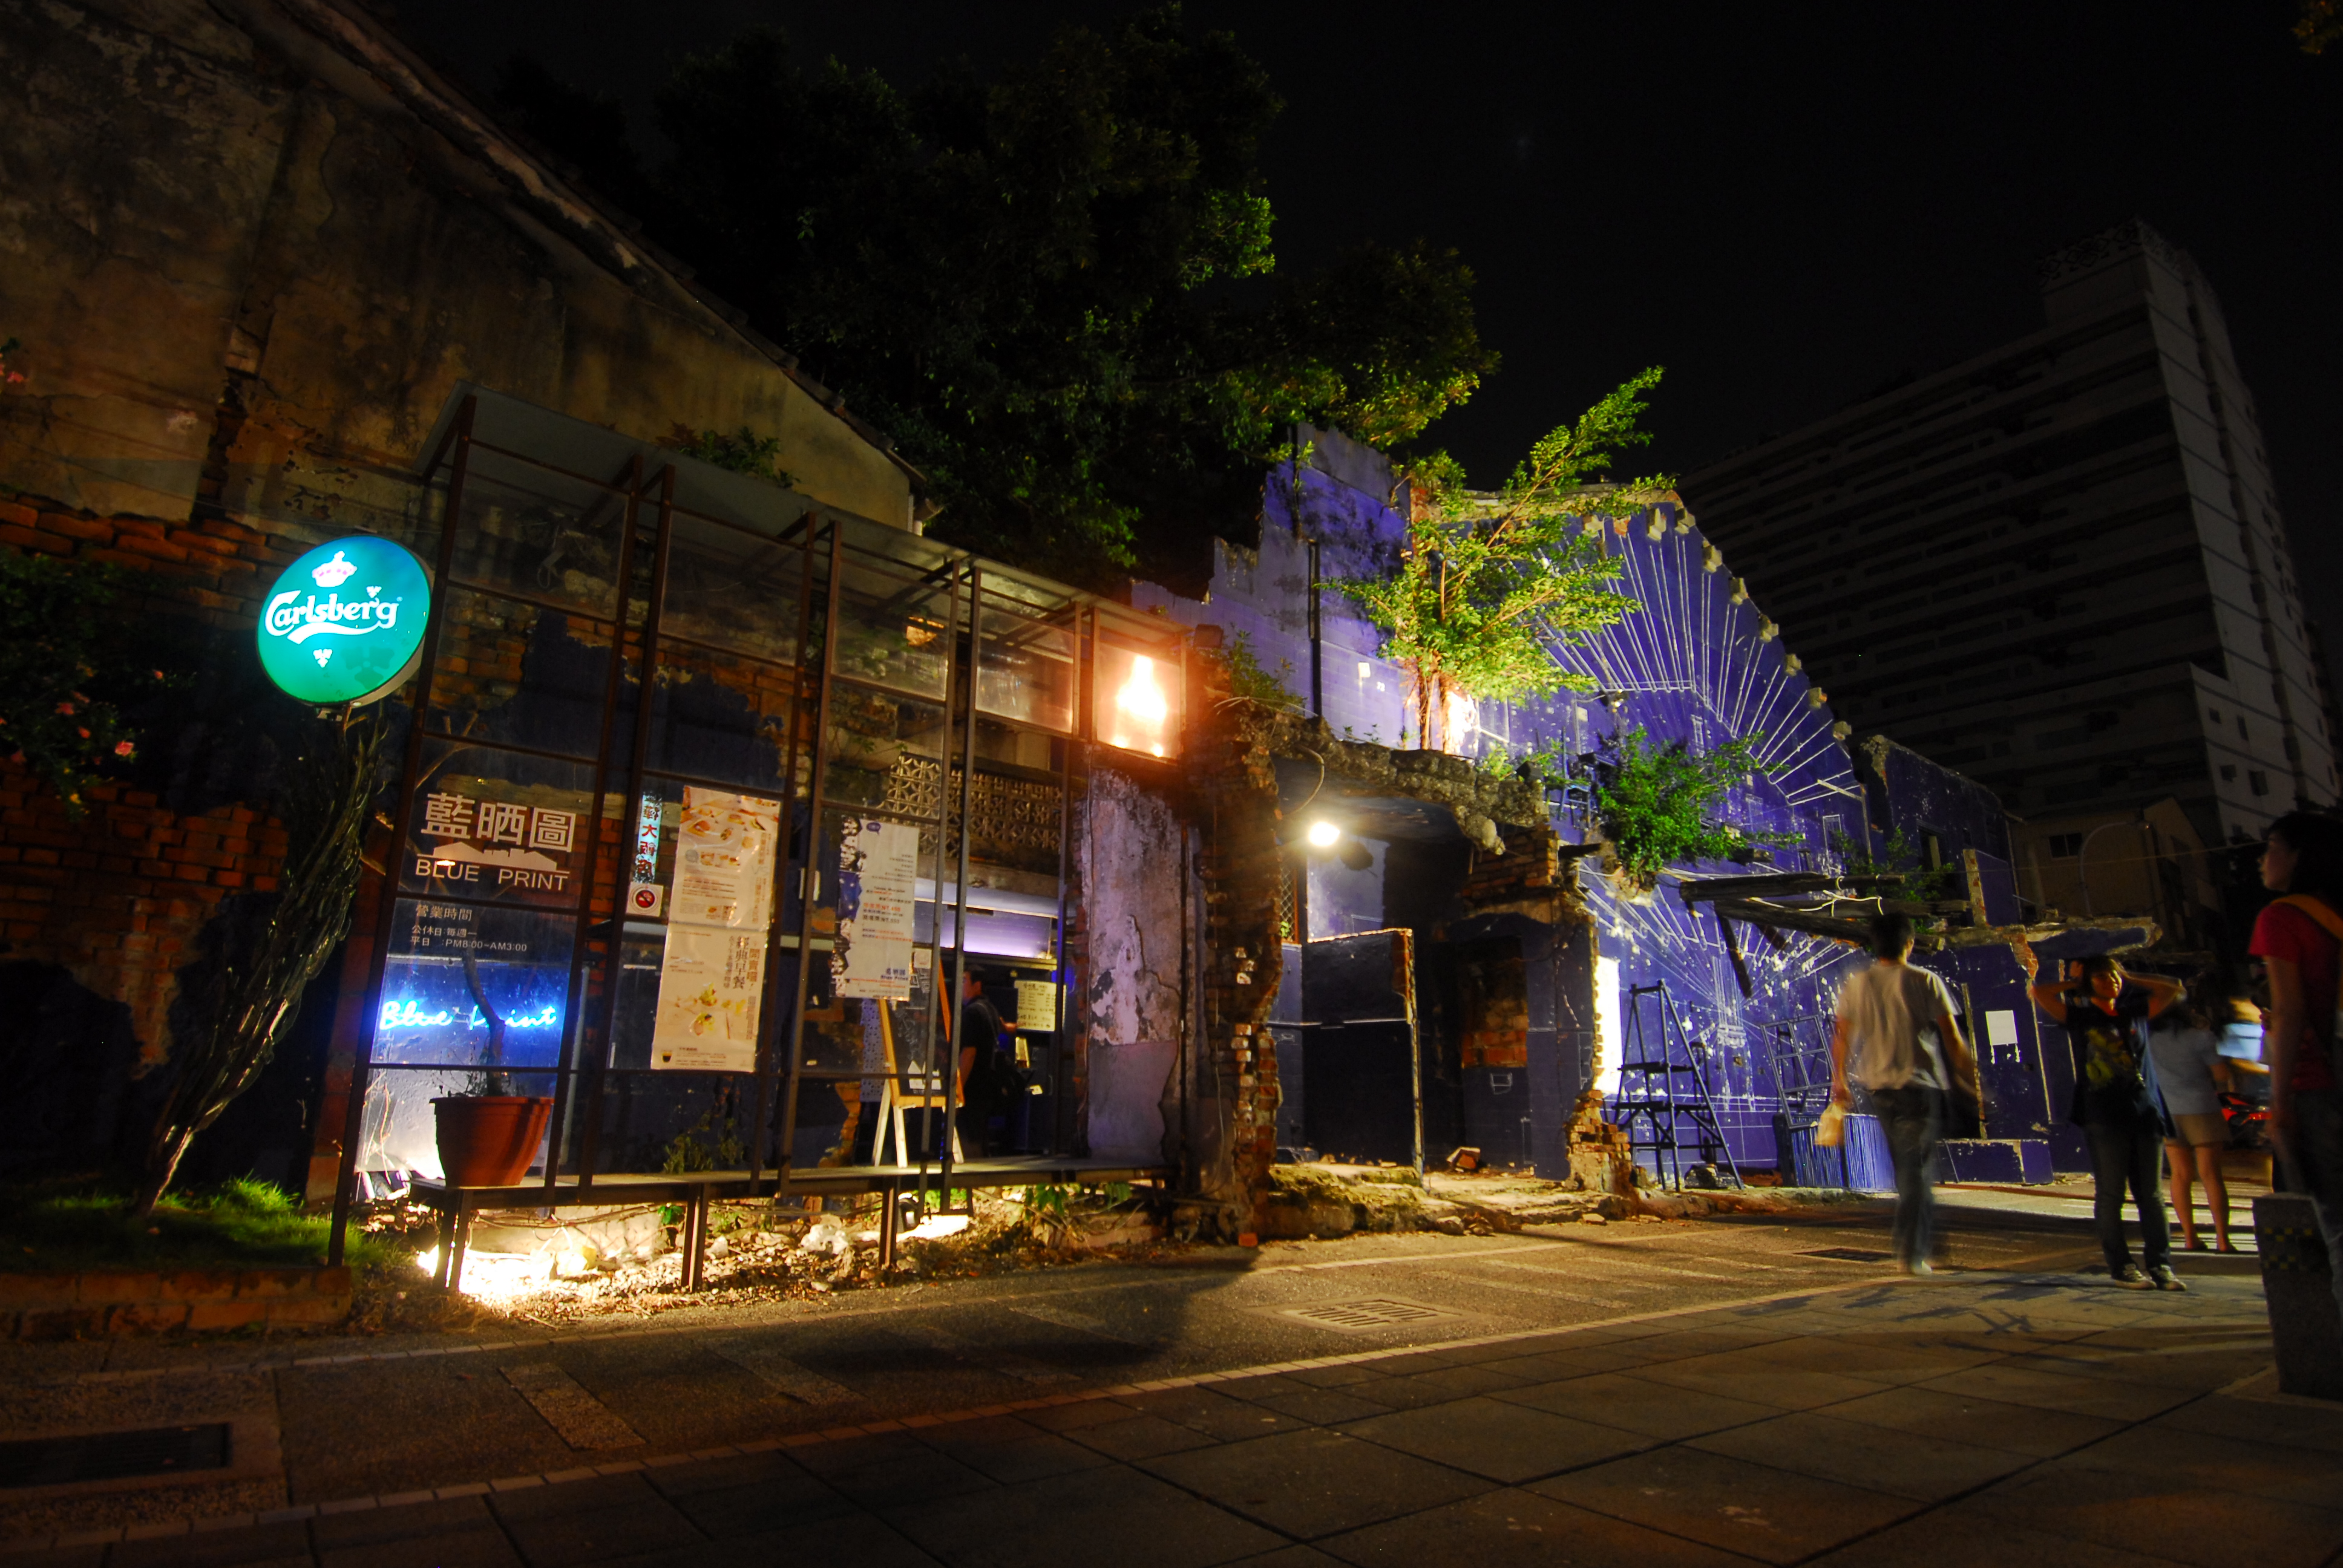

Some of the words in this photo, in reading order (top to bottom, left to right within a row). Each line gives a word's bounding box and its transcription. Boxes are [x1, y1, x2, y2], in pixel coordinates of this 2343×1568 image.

[265, 590, 399, 641] Carlsberg
[421, 792, 576, 852] 藍晒圖
[415, 858, 480, 882] BLUE
[498, 868, 568, 891] PRINT
[416, 904, 472, 921] 營業時間
[380, 1000, 453, 1030] Blue
